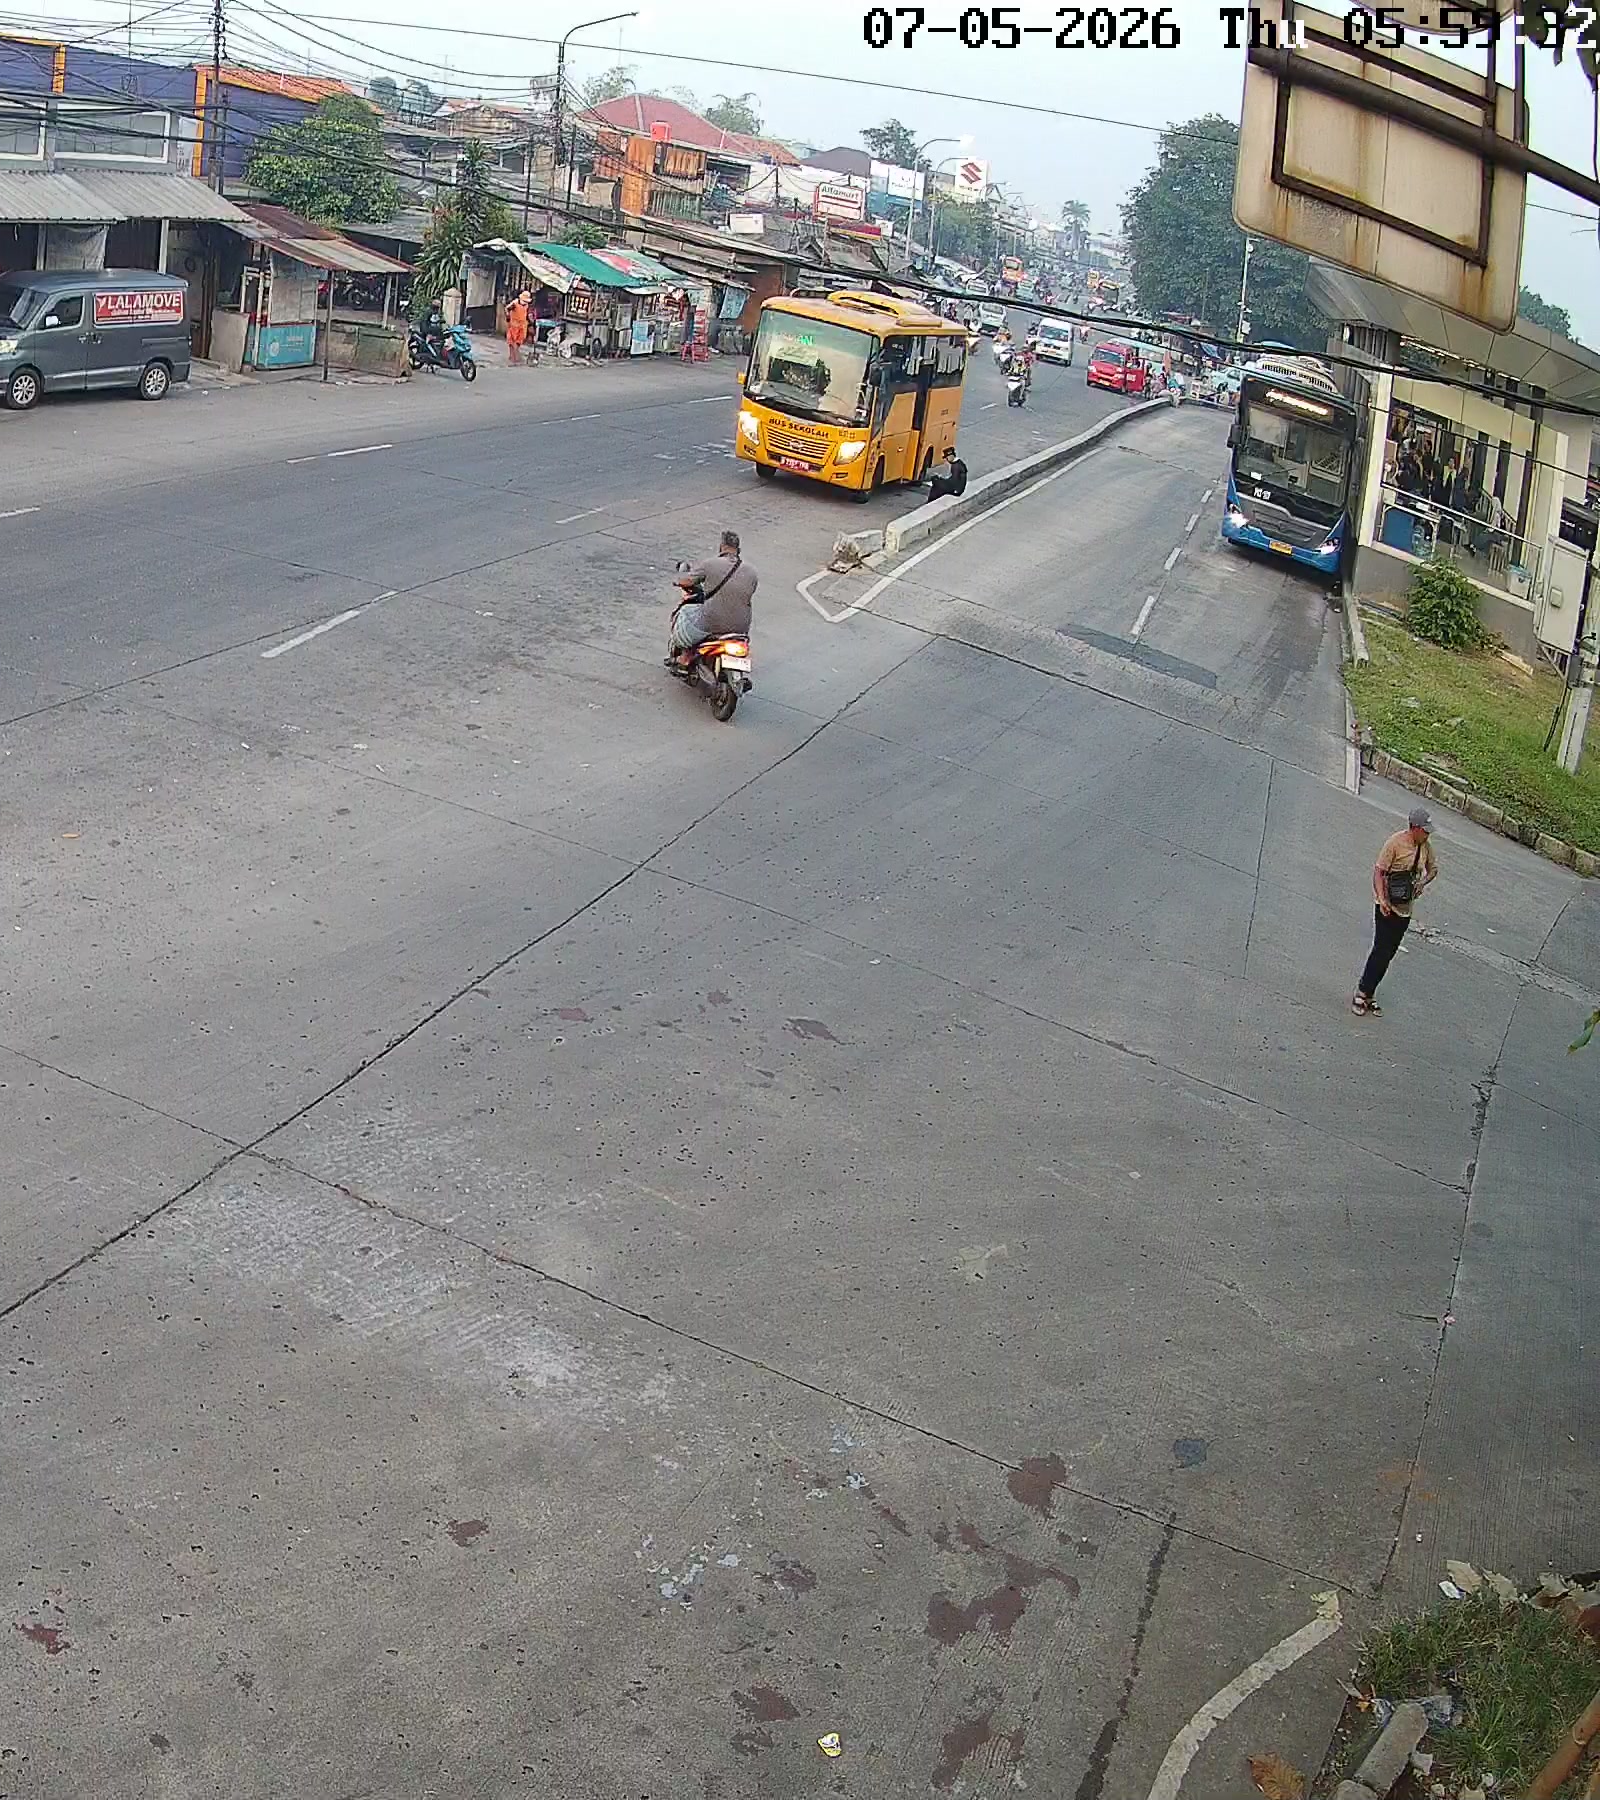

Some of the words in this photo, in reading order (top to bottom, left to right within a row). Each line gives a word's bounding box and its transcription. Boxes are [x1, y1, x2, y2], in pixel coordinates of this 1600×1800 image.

[821, 185, 860, 200] Alfamart
[107, 293, 181, 310] LALAMOVE
[768, 417, 787, 428] BUS
[788, 422, 829, 440] SEKOLAH
